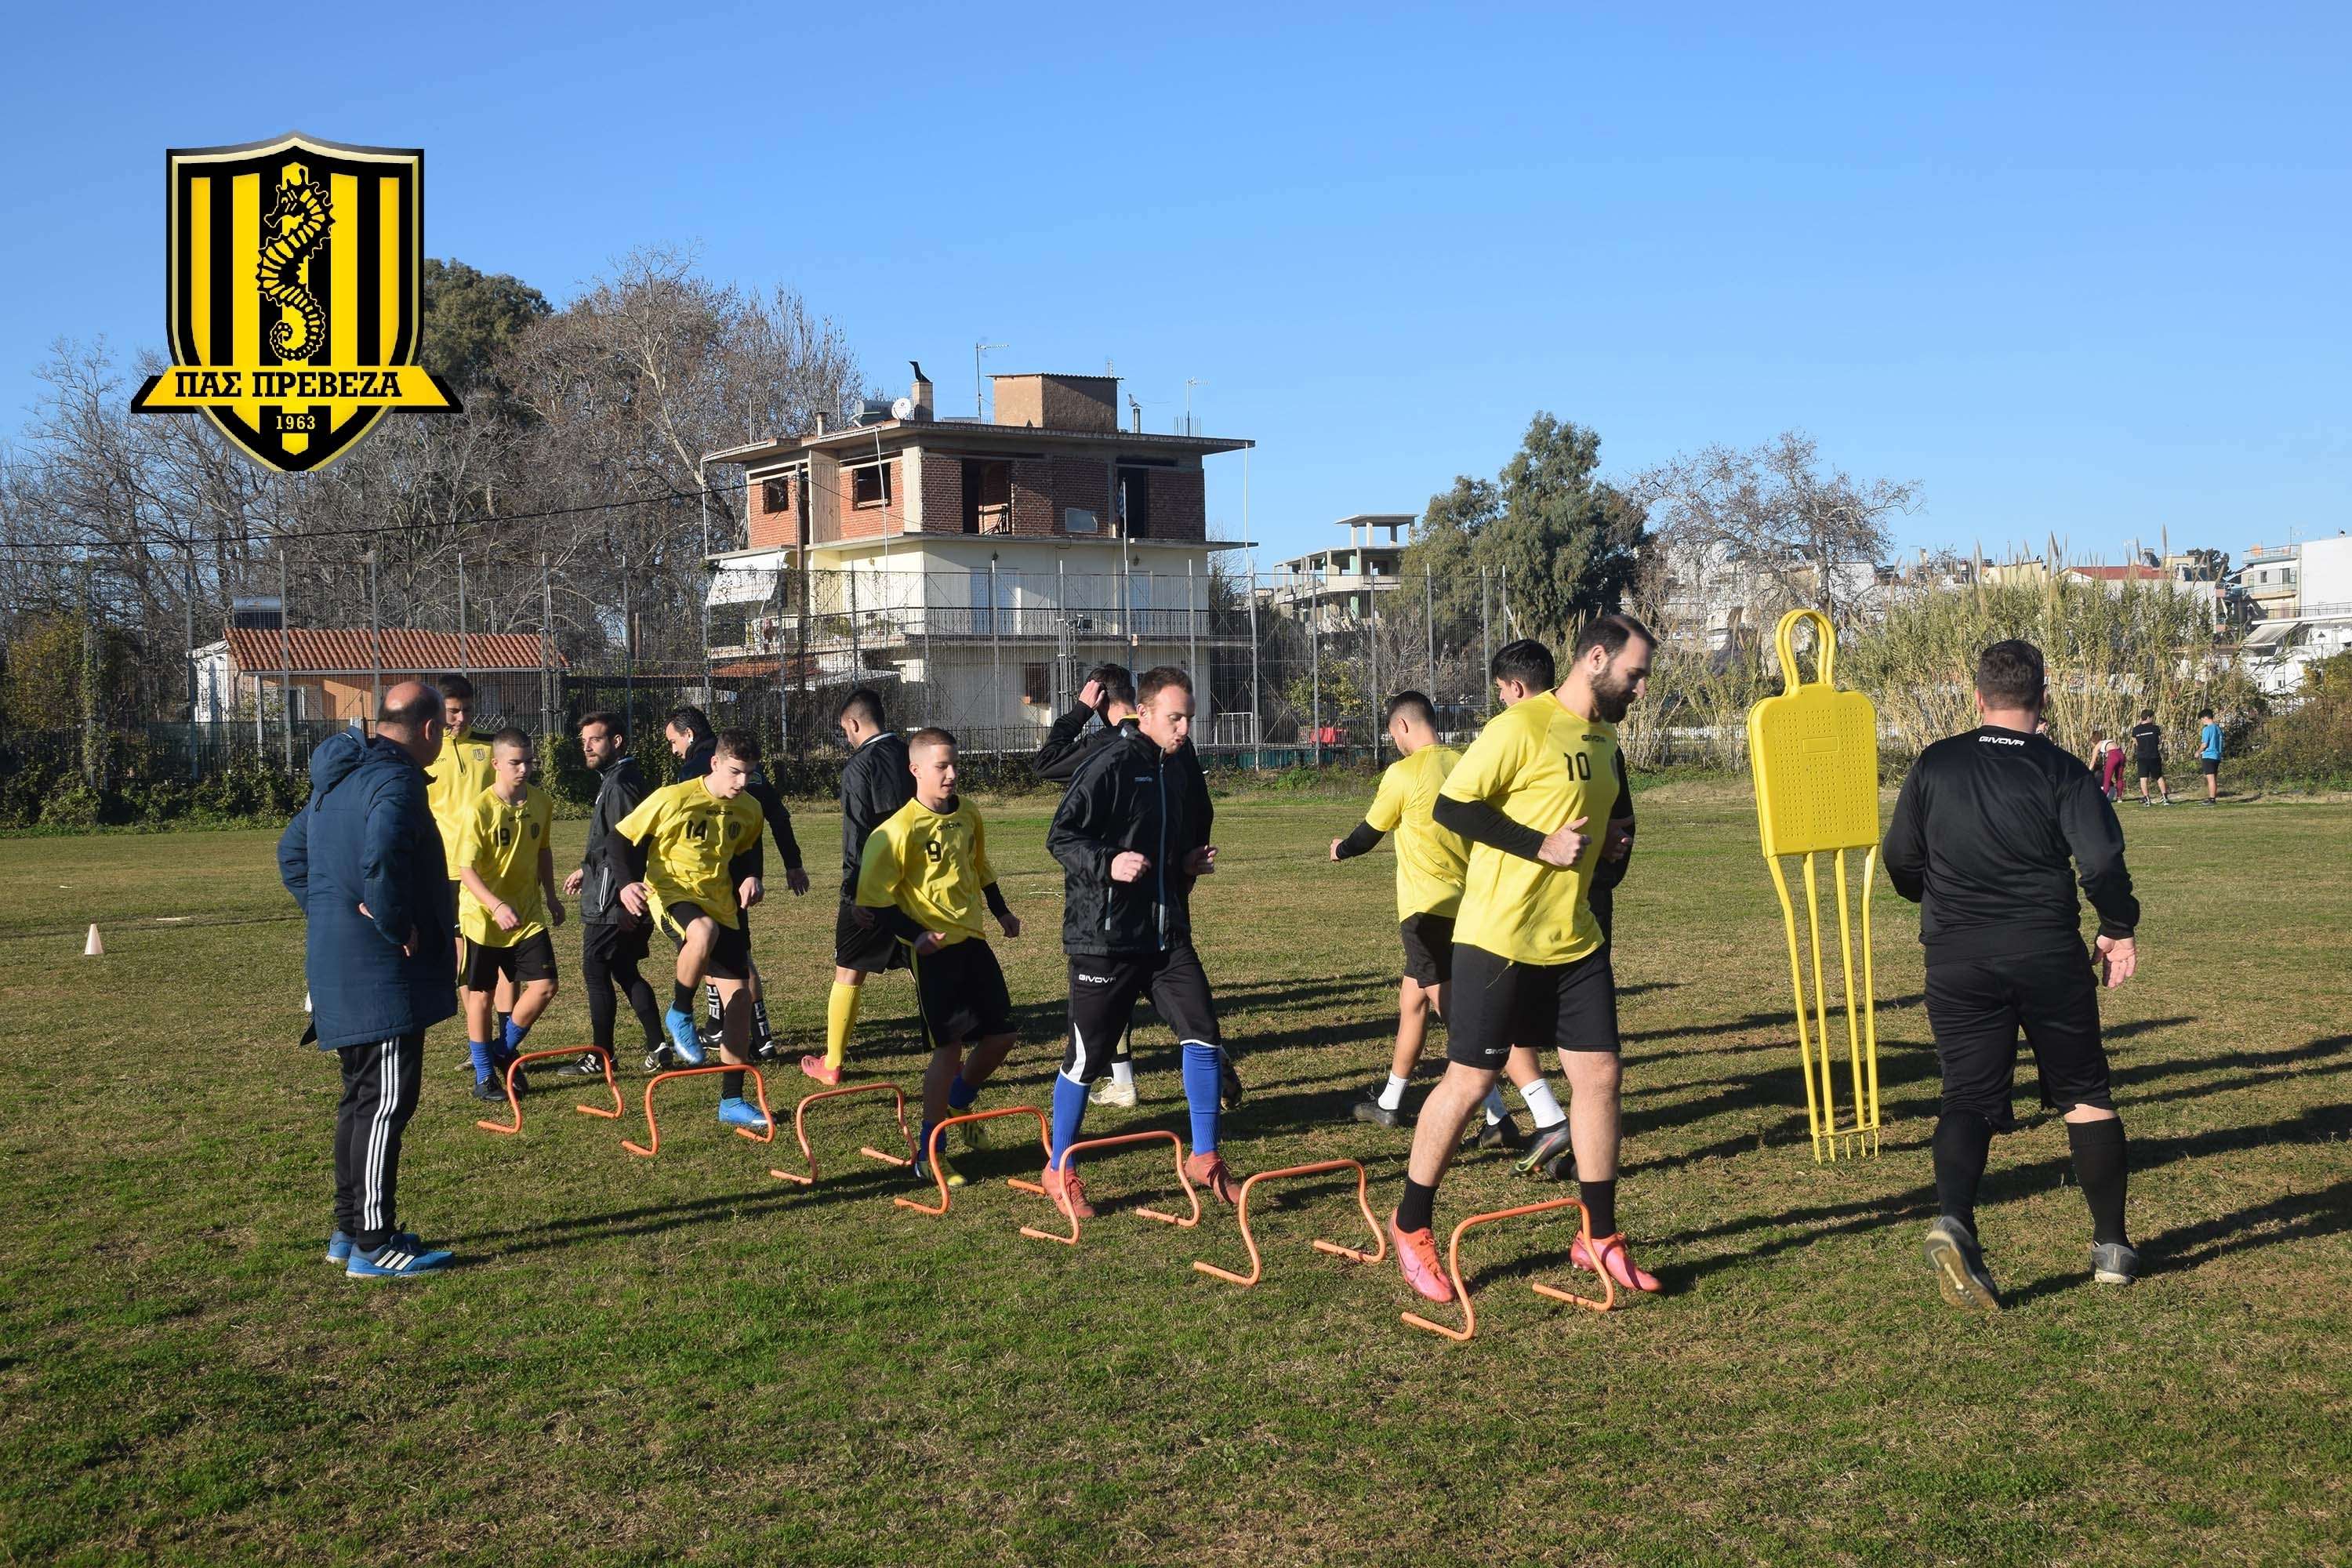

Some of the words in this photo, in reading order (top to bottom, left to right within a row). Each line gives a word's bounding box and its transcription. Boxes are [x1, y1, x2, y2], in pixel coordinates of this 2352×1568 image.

[1978, 735, 2025, 746] GIVOVA
[1563, 751, 1592, 782] 10
[495, 827, 511, 848] 19
[686, 819, 707, 841] 14
[926, 840, 942, 862] 9
